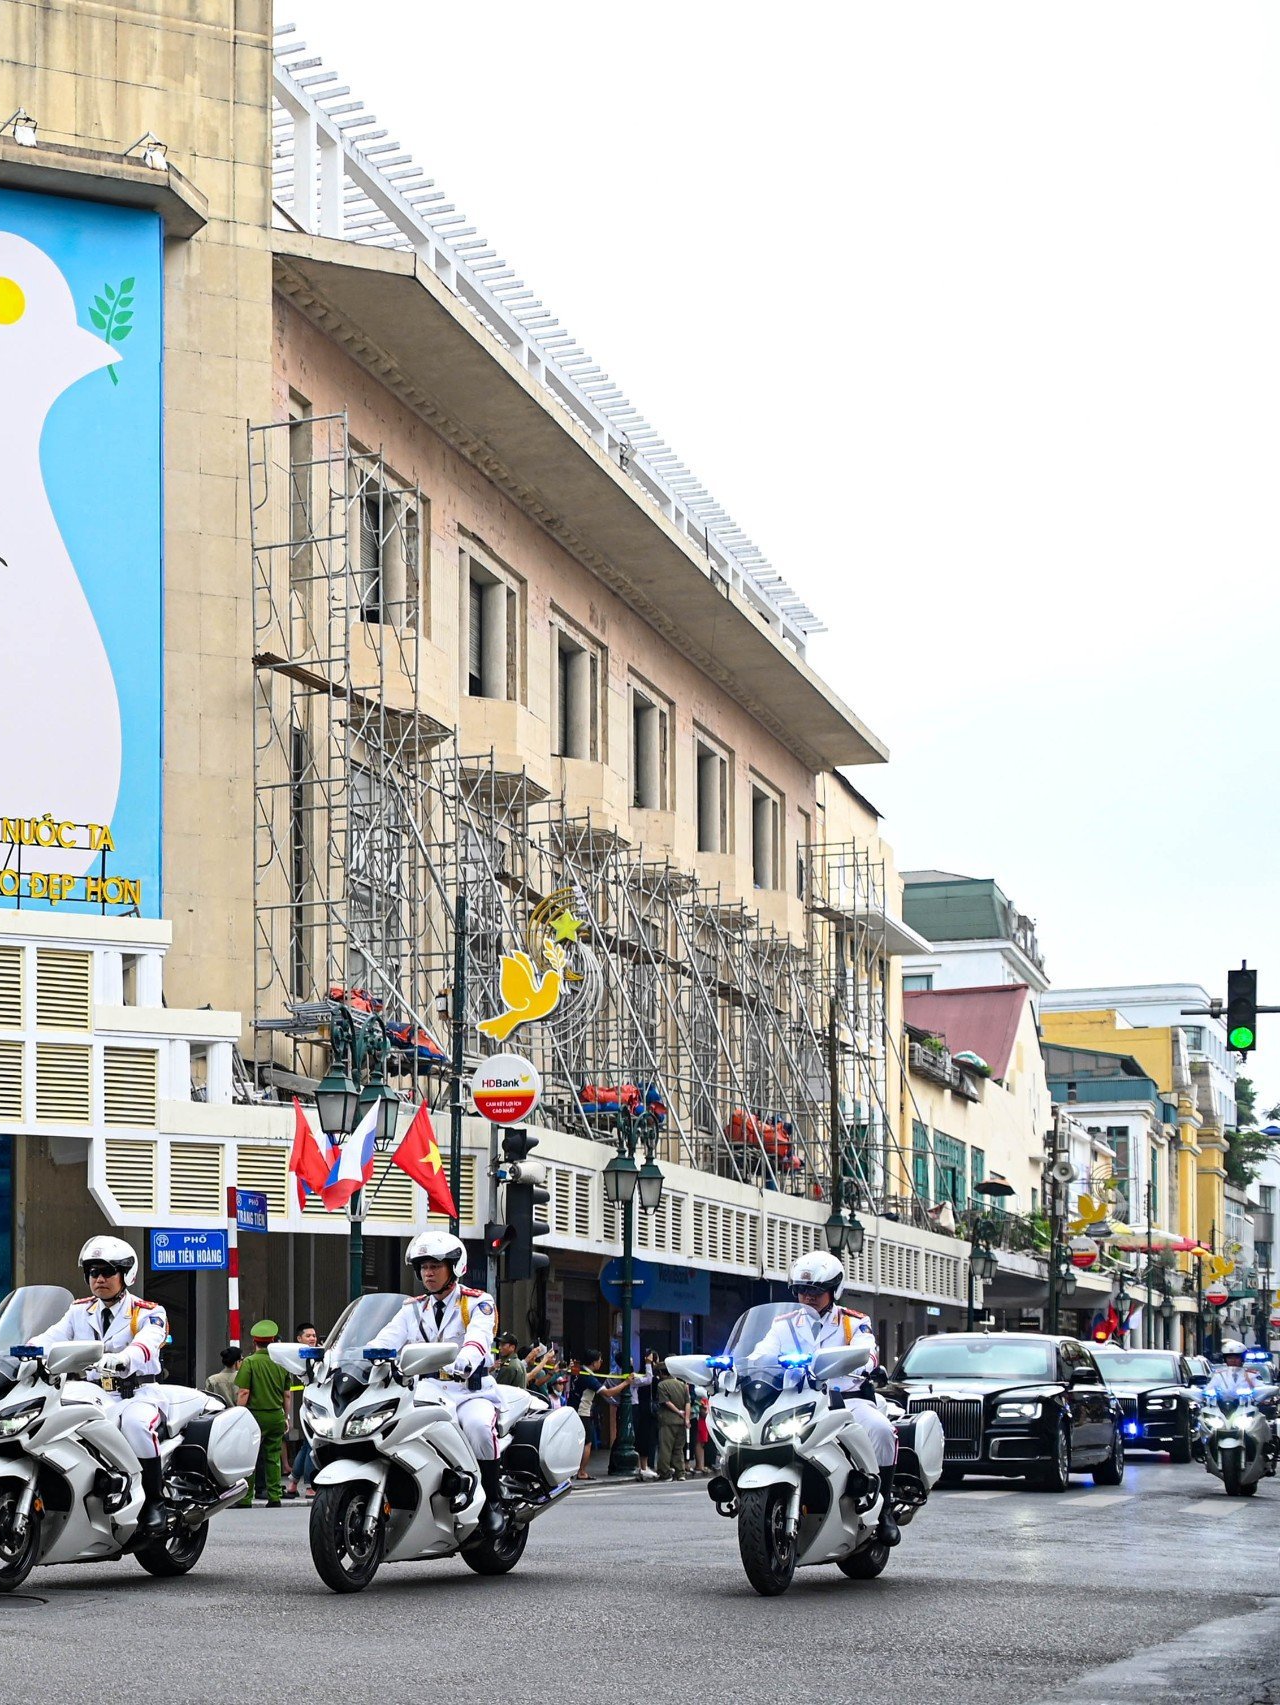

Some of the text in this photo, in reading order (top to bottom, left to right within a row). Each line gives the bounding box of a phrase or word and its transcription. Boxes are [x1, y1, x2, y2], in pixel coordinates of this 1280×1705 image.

[2, 813, 77, 848] NƯỚC
[88, 824, 115, 851] TA
[28, 872, 75, 906] ĐẸP
[86, 876, 141, 905] HƠN
[482, 1079, 519, 1087] HDBank
[237, 1208, 253, 1225] TRÀNG
[184, 1233, 207, 1243] PHỐ
[158, 1247, 221, 1263] ĐINH TIÊN HOÀNG
